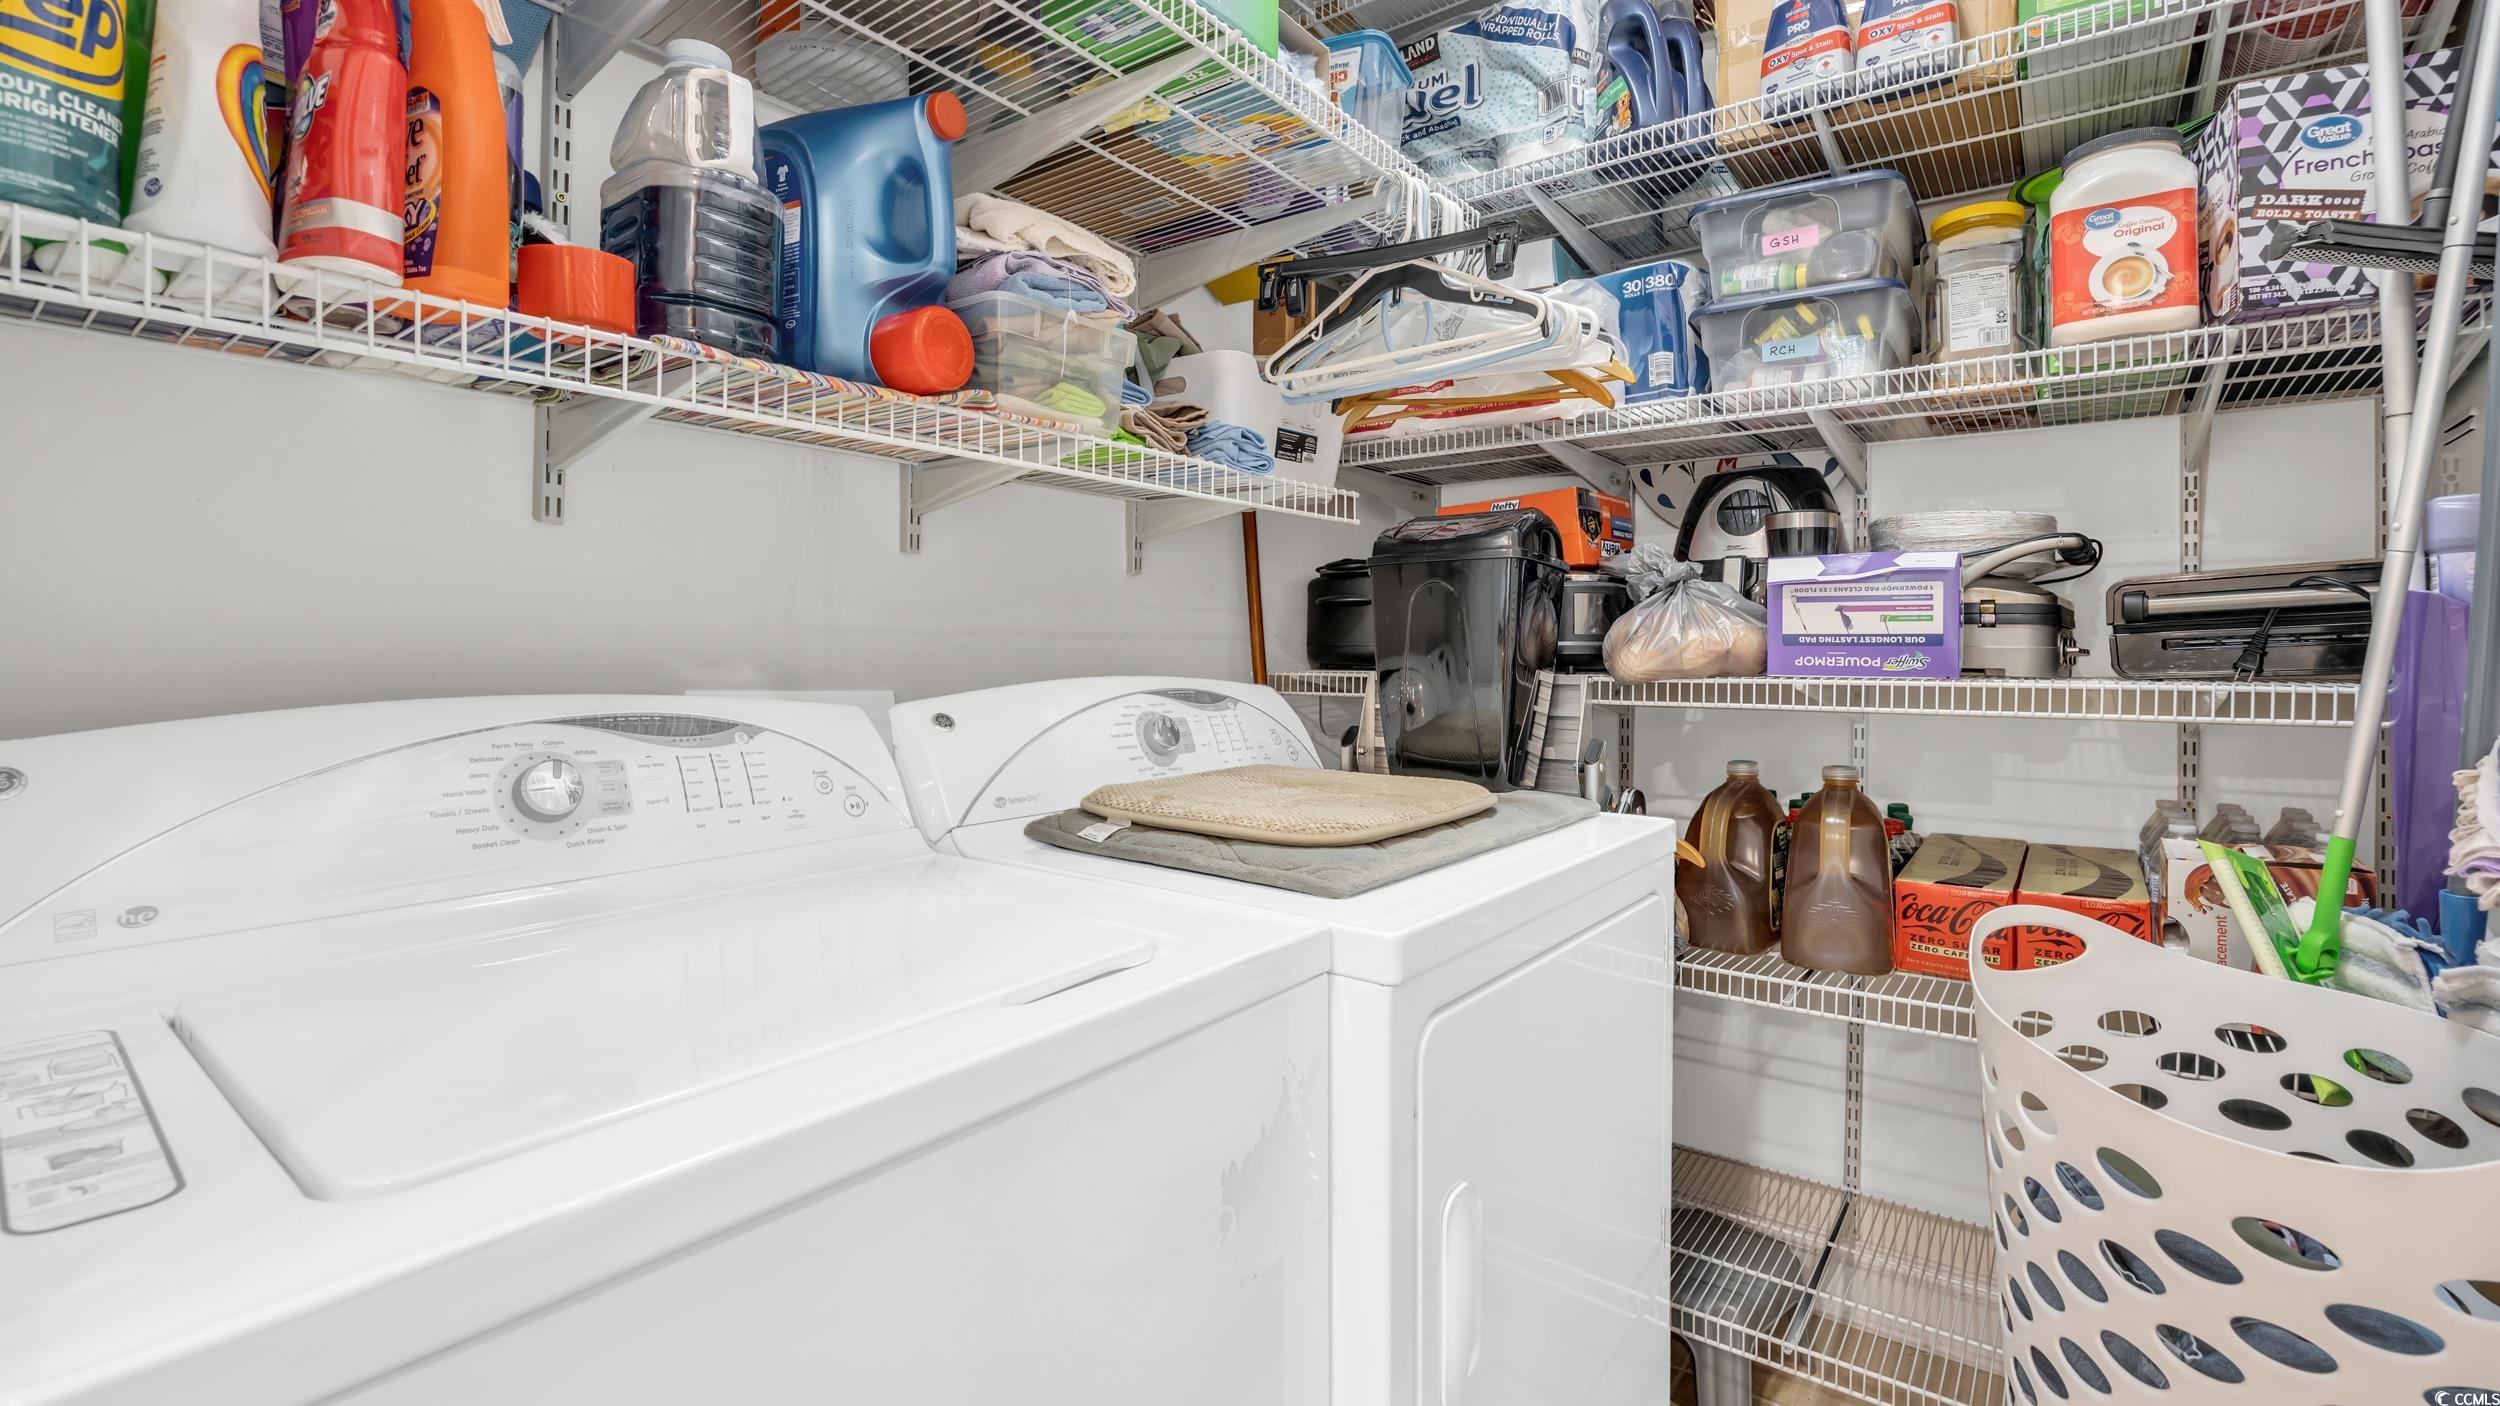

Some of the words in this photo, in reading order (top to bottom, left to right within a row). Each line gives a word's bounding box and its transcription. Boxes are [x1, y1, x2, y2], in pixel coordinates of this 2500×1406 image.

[1889, 5, 1924, 20] ADVANCED
[1787, 19, 1811, 36] PRO
[1869, 25, 1894, 39] OXY
[1896, 19, 1915, 30] Spot
[1924, 11, 1944, 22] Stain
[1480, 22, 1525, 37] WRAPPED
[1526, 27, 1560, 41] ROLLS
[1768, 54, 1790, 69] OXY
[1791, 47, 1808, 59] Spot
[1815, 39, 1834, 50] Stain
[2307, 119, 2353, 139] Great
[2316, 132, 2353, 144] Value
[2294, 150, 2375, 176] French
[2259, 193, 2325, 206] DARK
[2089, 211, 2115, 223] Great
[2255, 209, 2291, 220] BOLD
[2293, 210, 2302, 219] &
[2303, 208, 2358, 220] TOASTY
[2095, 218, 2115, 227] Value
[2113, 221, 2165, 238] Original
[1769, 234, 1799, 248] GSH
[1622, 279, 1641, 294] 30
[1645, 273, 1676, 288] 380
[1624, 291, 1640, 299] ROLLS
[1769, 344, 1796, 357] RCH
[1492, 500, 1518, 511] Hefty
[1880, 584, 1929, 592] POWERMOP
[1794, 656, 1881, 667] POWERMOP
[1885, 653, 1931, 671] Swiffer
[469, 755, 504, 764] Delicates
[442, 789, 464, 798] Hand
[465, 788, 487, 797] Wash
[429, 809, 457, 819] Towels
[463, 807, 490, 816] Sheets
[455, 826, 480, 836] Heavy
[481, 824, 500, 833] Duty
[587, 825, 605, 834] Drain
[613, 823, 628, 833] Spin
[472, 840, 498, 850] Basket
[499, 838, 521, 847] Clean
[565, 840, 586, 849] Quick
[586, 838, 605, 847] Rinse
[1909, 933, 1946, 946] ZERO
[1910, 943, 1939, 954] ZERO
[2034, 948, 2075, 960] ZERO
